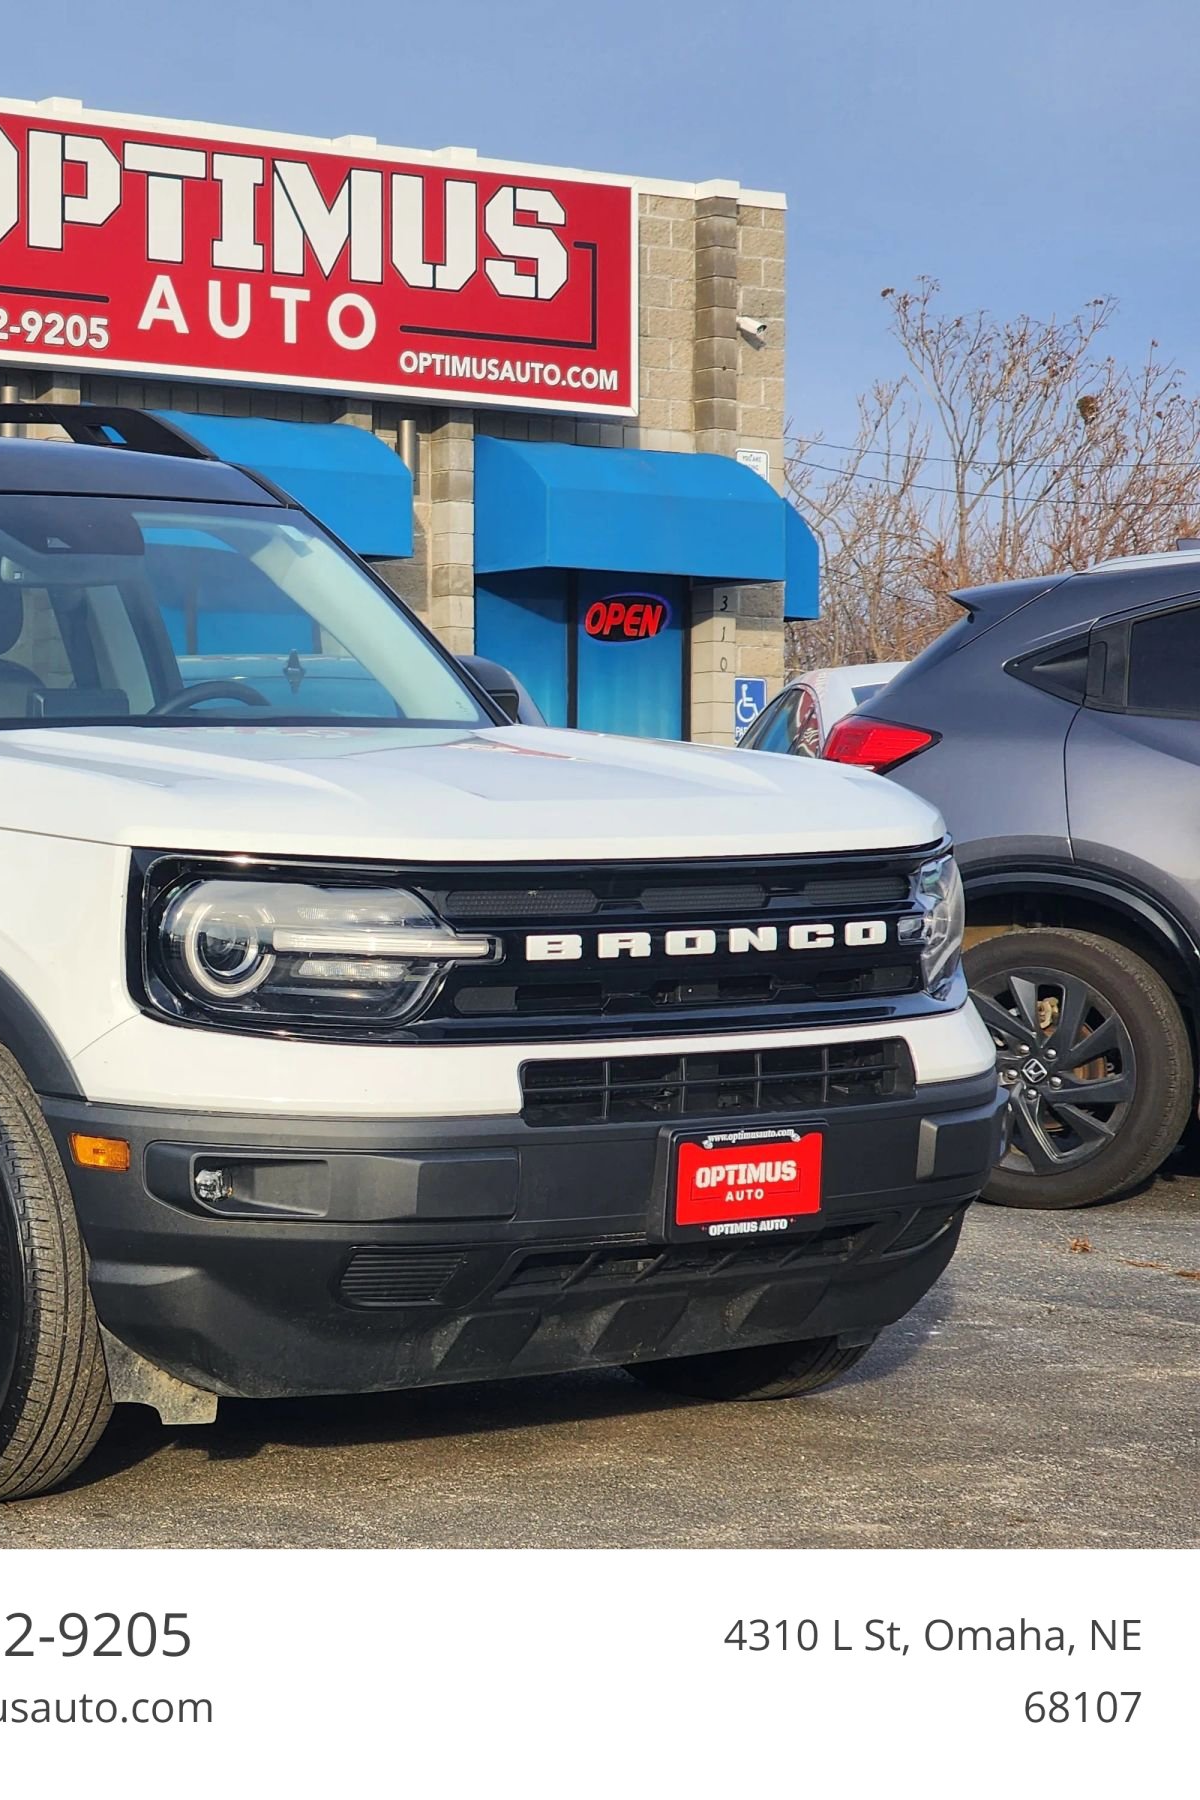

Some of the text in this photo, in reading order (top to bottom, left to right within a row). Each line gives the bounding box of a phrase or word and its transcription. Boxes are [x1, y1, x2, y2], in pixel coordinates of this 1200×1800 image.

[136, 273, 378, 350] AUTO
[399, 350, 619, 391] OPTIMUSAUTO.COM
[585, 603, 662, 637] OPEN
[526, 920, 887, 961] BRONCO
[707, 1128, 795, 1143] www.optimusauto.com
[695, 1159, 797, 1189] OPTIMUS
[725, 1188, 765, 1202] AUTO
[708, 1218, 788, 1237] OPTIMUS AUTO
